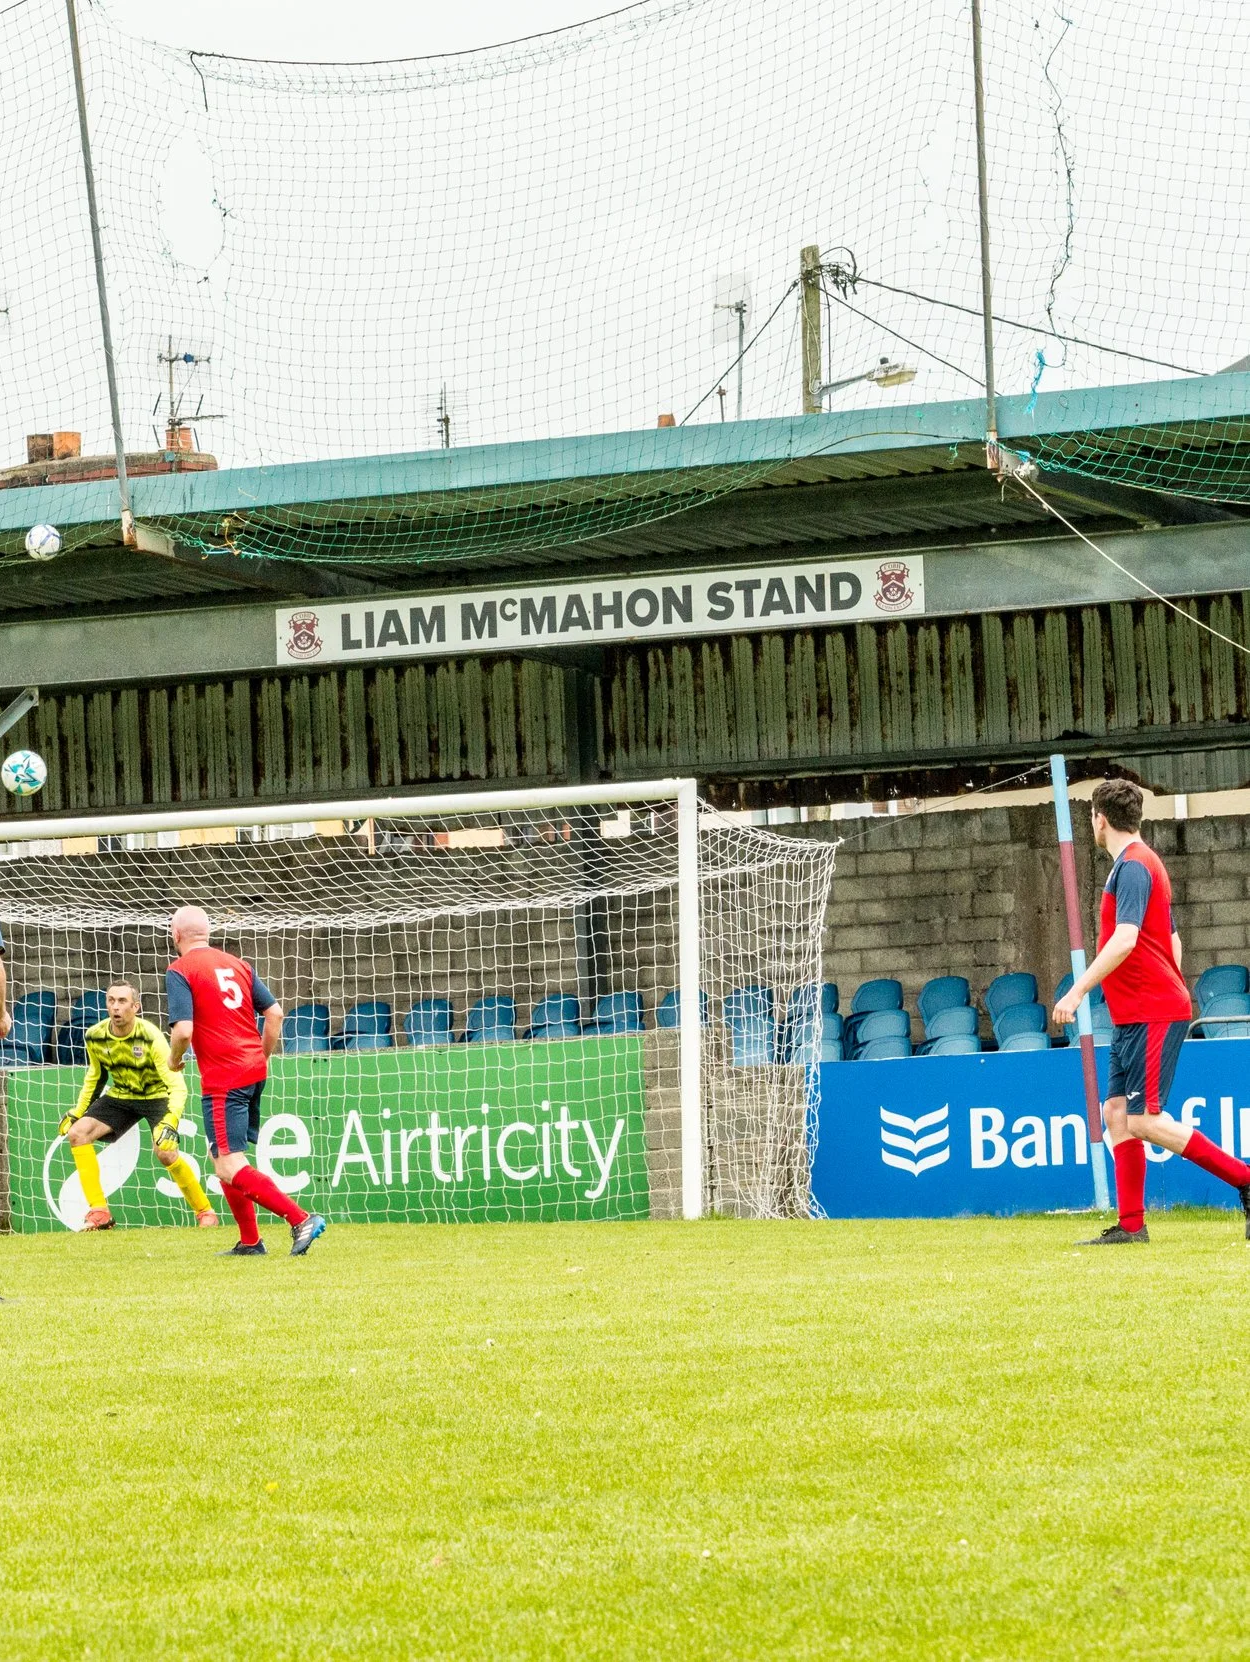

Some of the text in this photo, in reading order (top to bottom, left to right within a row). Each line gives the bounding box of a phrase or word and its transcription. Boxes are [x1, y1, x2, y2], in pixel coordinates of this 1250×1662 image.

[341, 571, 862, 650] LIAM McMAHON STAND
[214, 967, 243, 1010] 5
[332, 1100, 625, 1199] Airtricity
